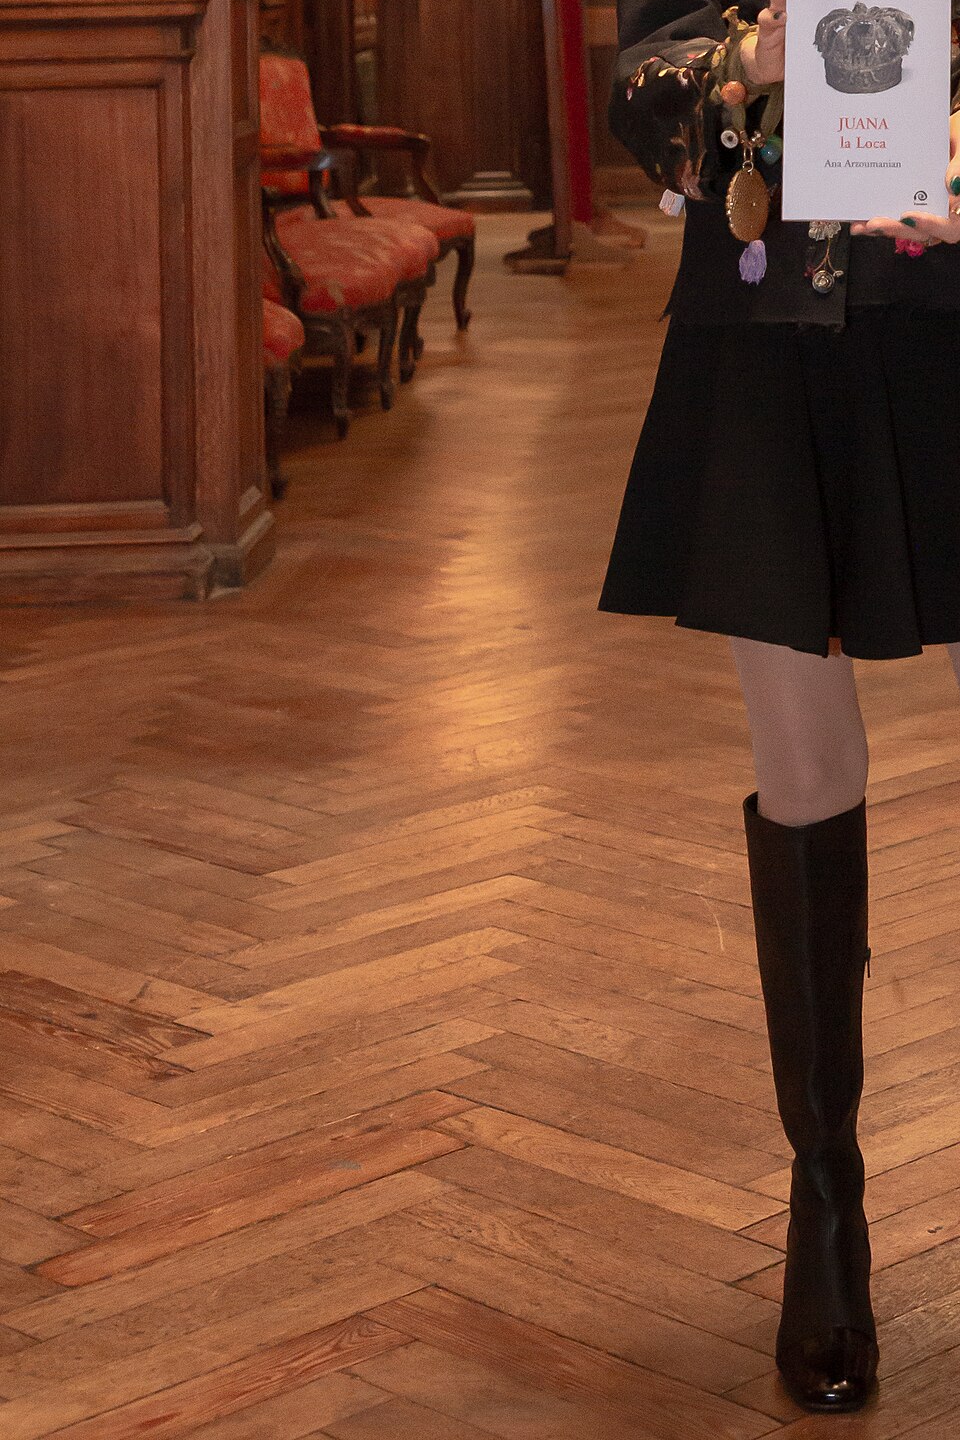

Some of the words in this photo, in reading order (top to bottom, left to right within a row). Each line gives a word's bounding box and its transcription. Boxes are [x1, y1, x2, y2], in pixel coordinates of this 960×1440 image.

[837, 117, 889, 132] JUANA
[840, 136, 851, 149] la
[856, 136, 887, 149] Loca
[824, 159, 842, 168] Ana
[844, 159, 902, 168] Arzoumanian
